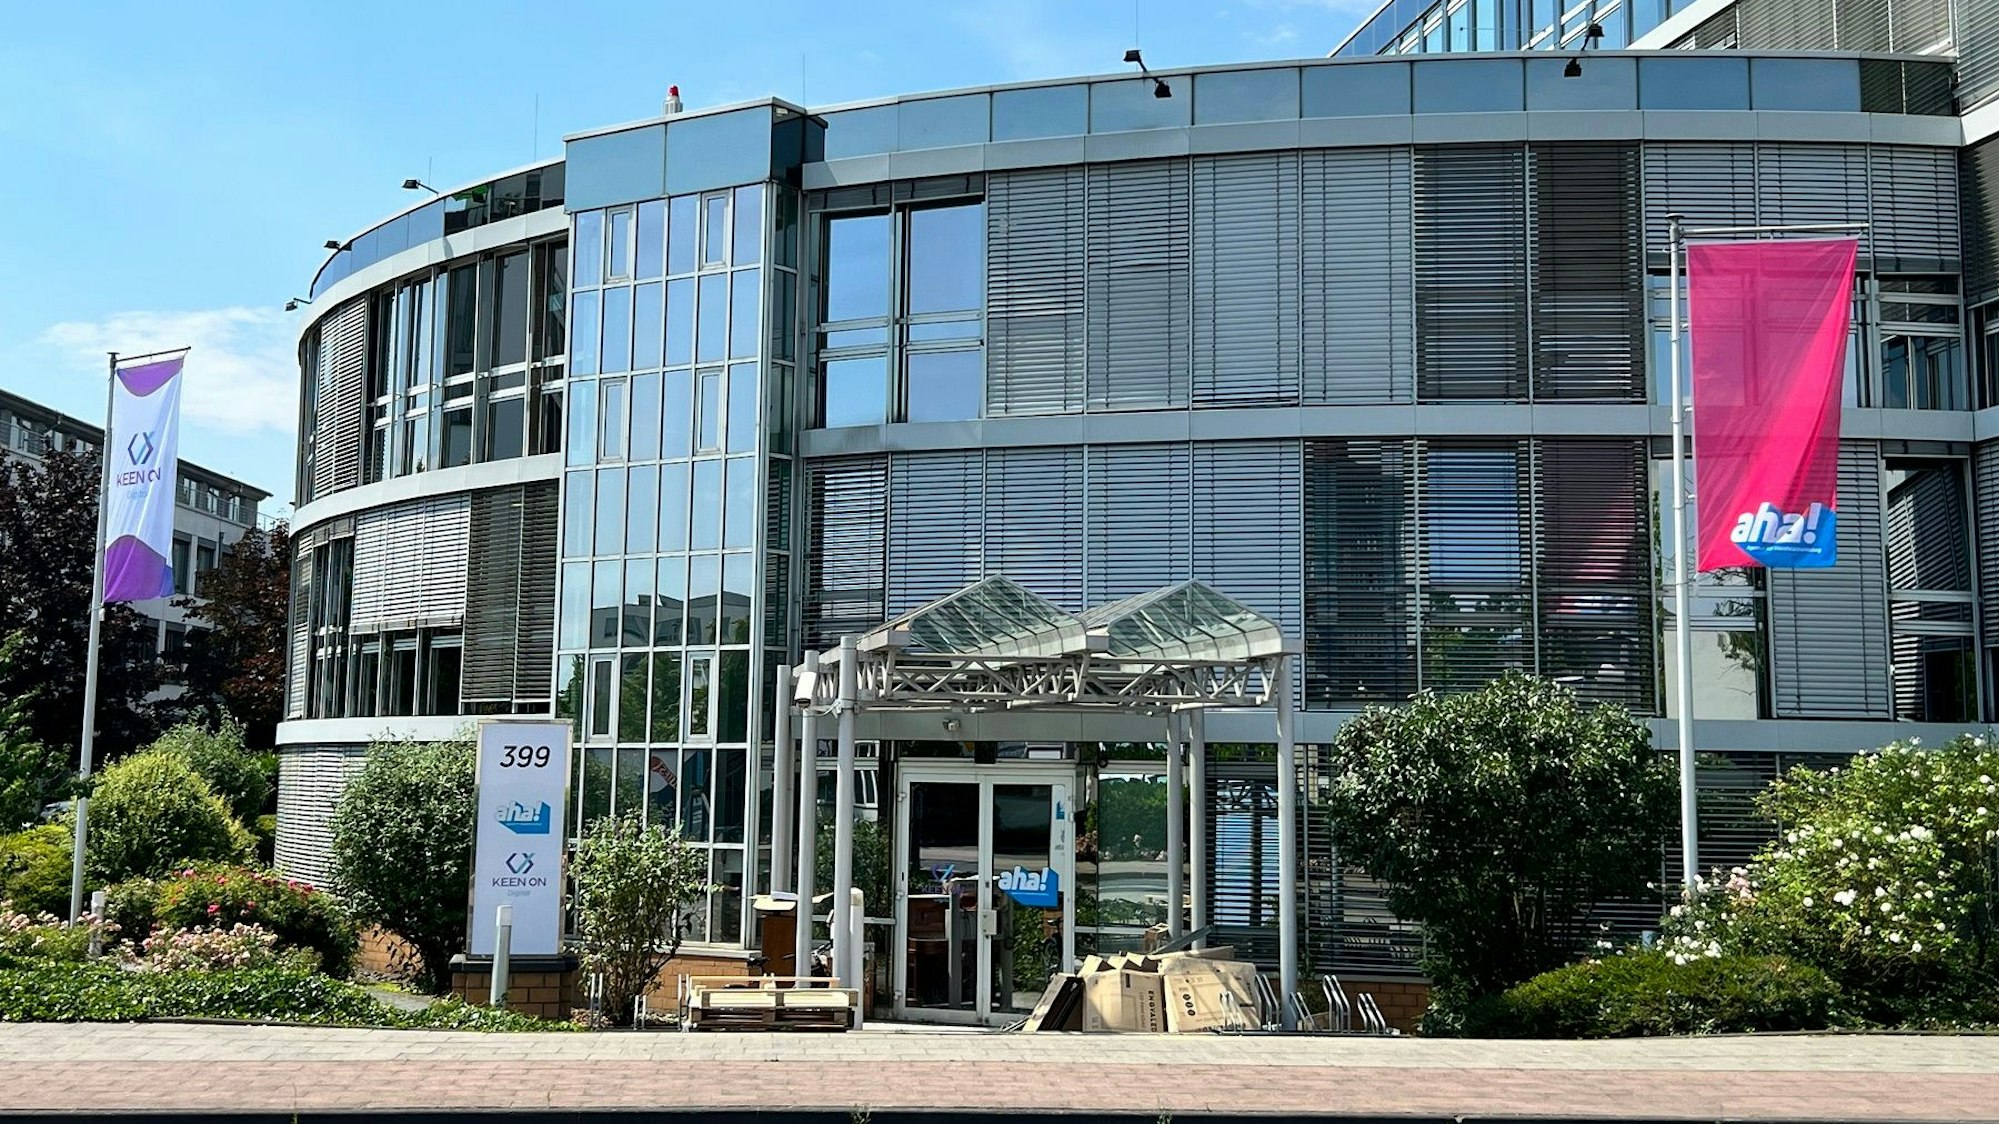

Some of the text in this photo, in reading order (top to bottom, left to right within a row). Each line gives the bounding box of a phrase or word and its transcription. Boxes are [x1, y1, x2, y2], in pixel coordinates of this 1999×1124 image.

[116, 469, 145, 488] KEEN
[1730, 501, 1822, 545] aha!
[500, 745, 551, 768] 399
[495, 800, 543, 822] aha!
[492, 877, 547, 887] KEEN ON
[998, 865, 1050, 891] aha!
